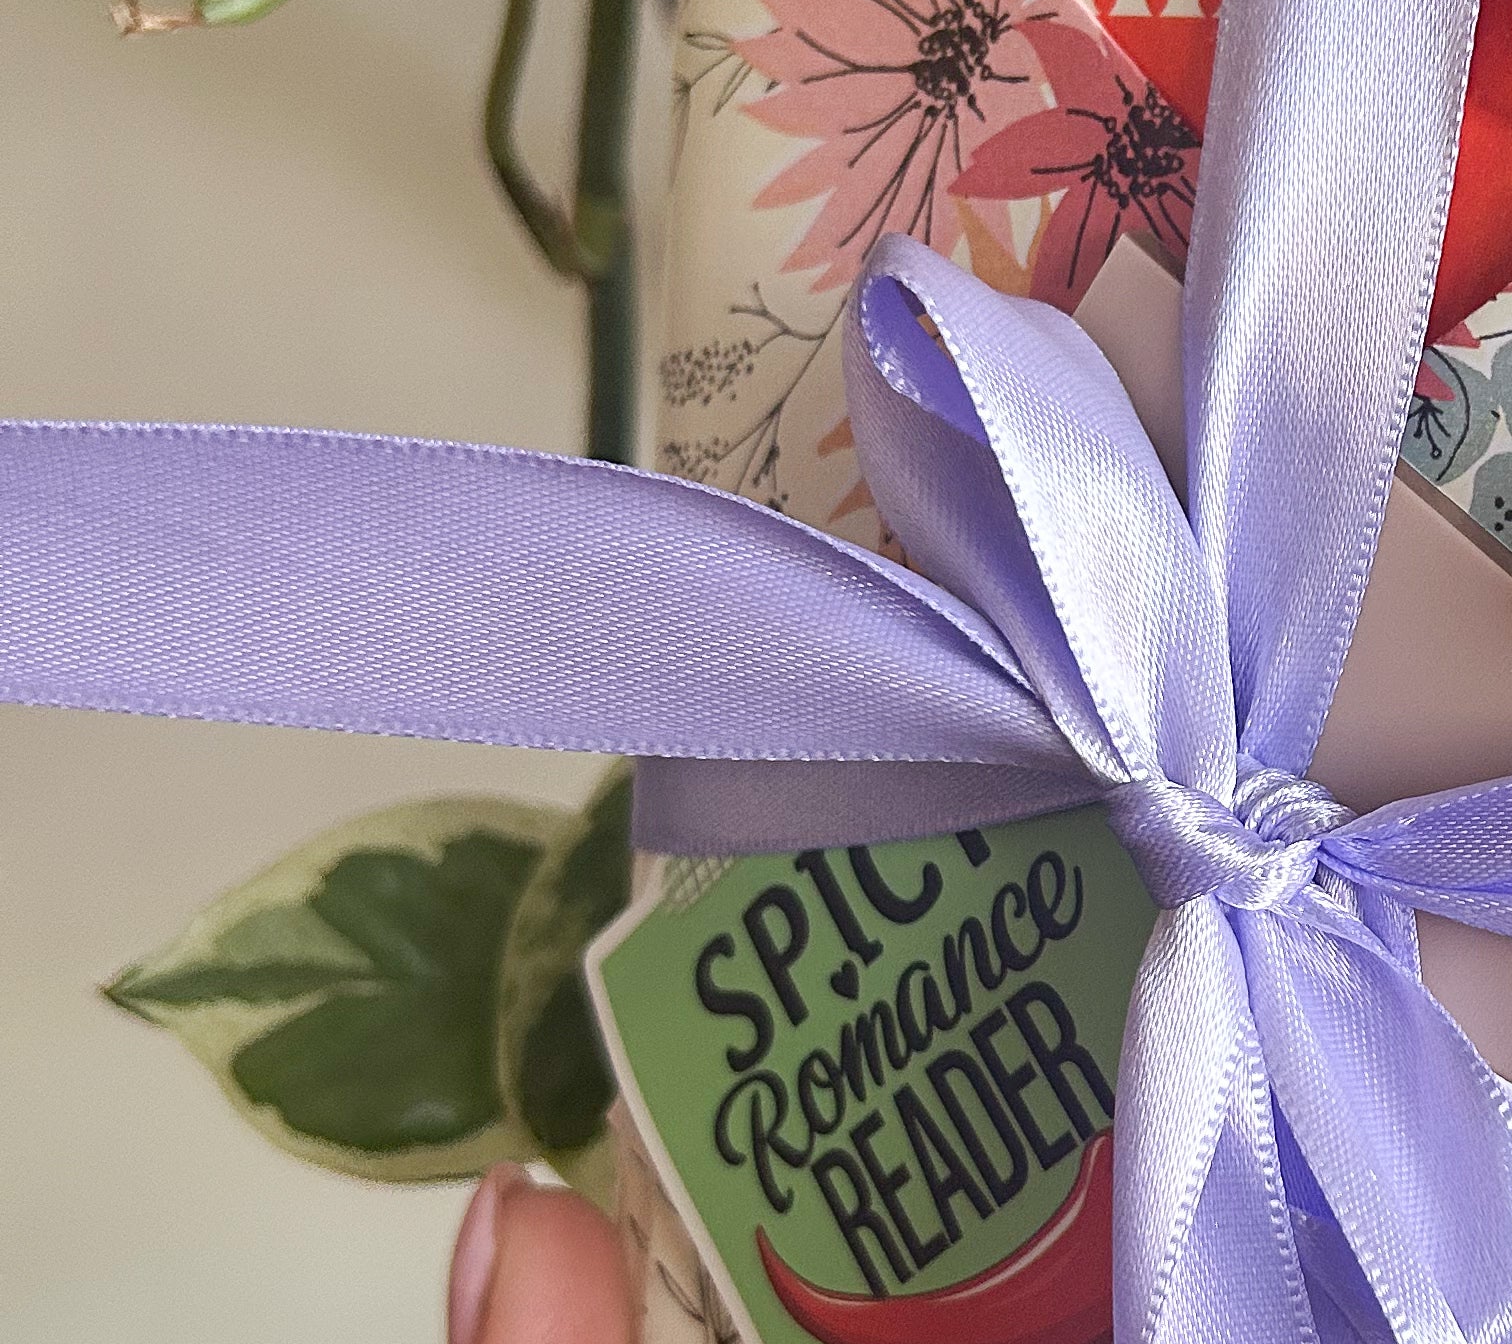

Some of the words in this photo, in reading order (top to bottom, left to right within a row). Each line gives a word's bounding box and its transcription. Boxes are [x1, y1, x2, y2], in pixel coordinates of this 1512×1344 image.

[694, 827, 992, 1073] SPIC
[714, 850, 1084, 1215] Romance
[811, 980, 1116, 1299] READER
